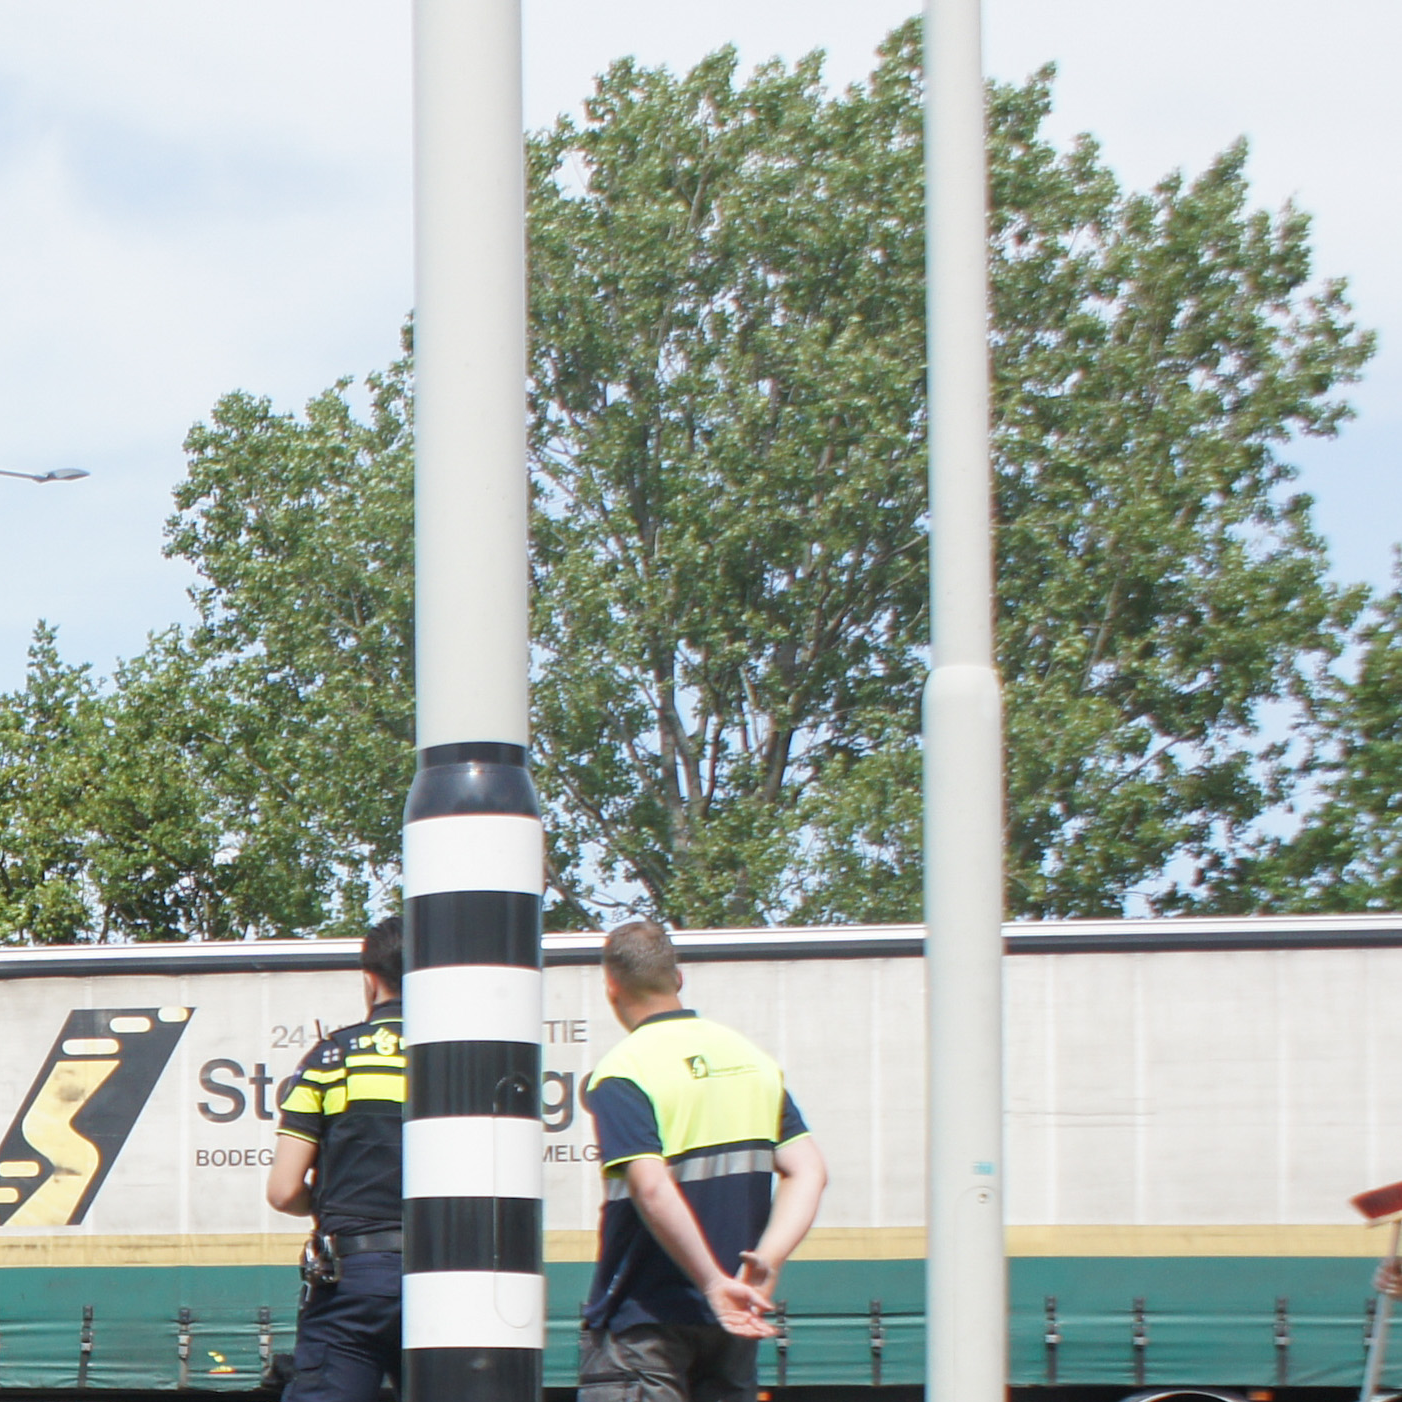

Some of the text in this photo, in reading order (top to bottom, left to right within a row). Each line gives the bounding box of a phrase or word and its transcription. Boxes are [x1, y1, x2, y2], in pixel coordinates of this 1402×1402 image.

[542, 1020, 588, 1043] TIE
[196, 1144, 600, 1167] BODEG MELG
